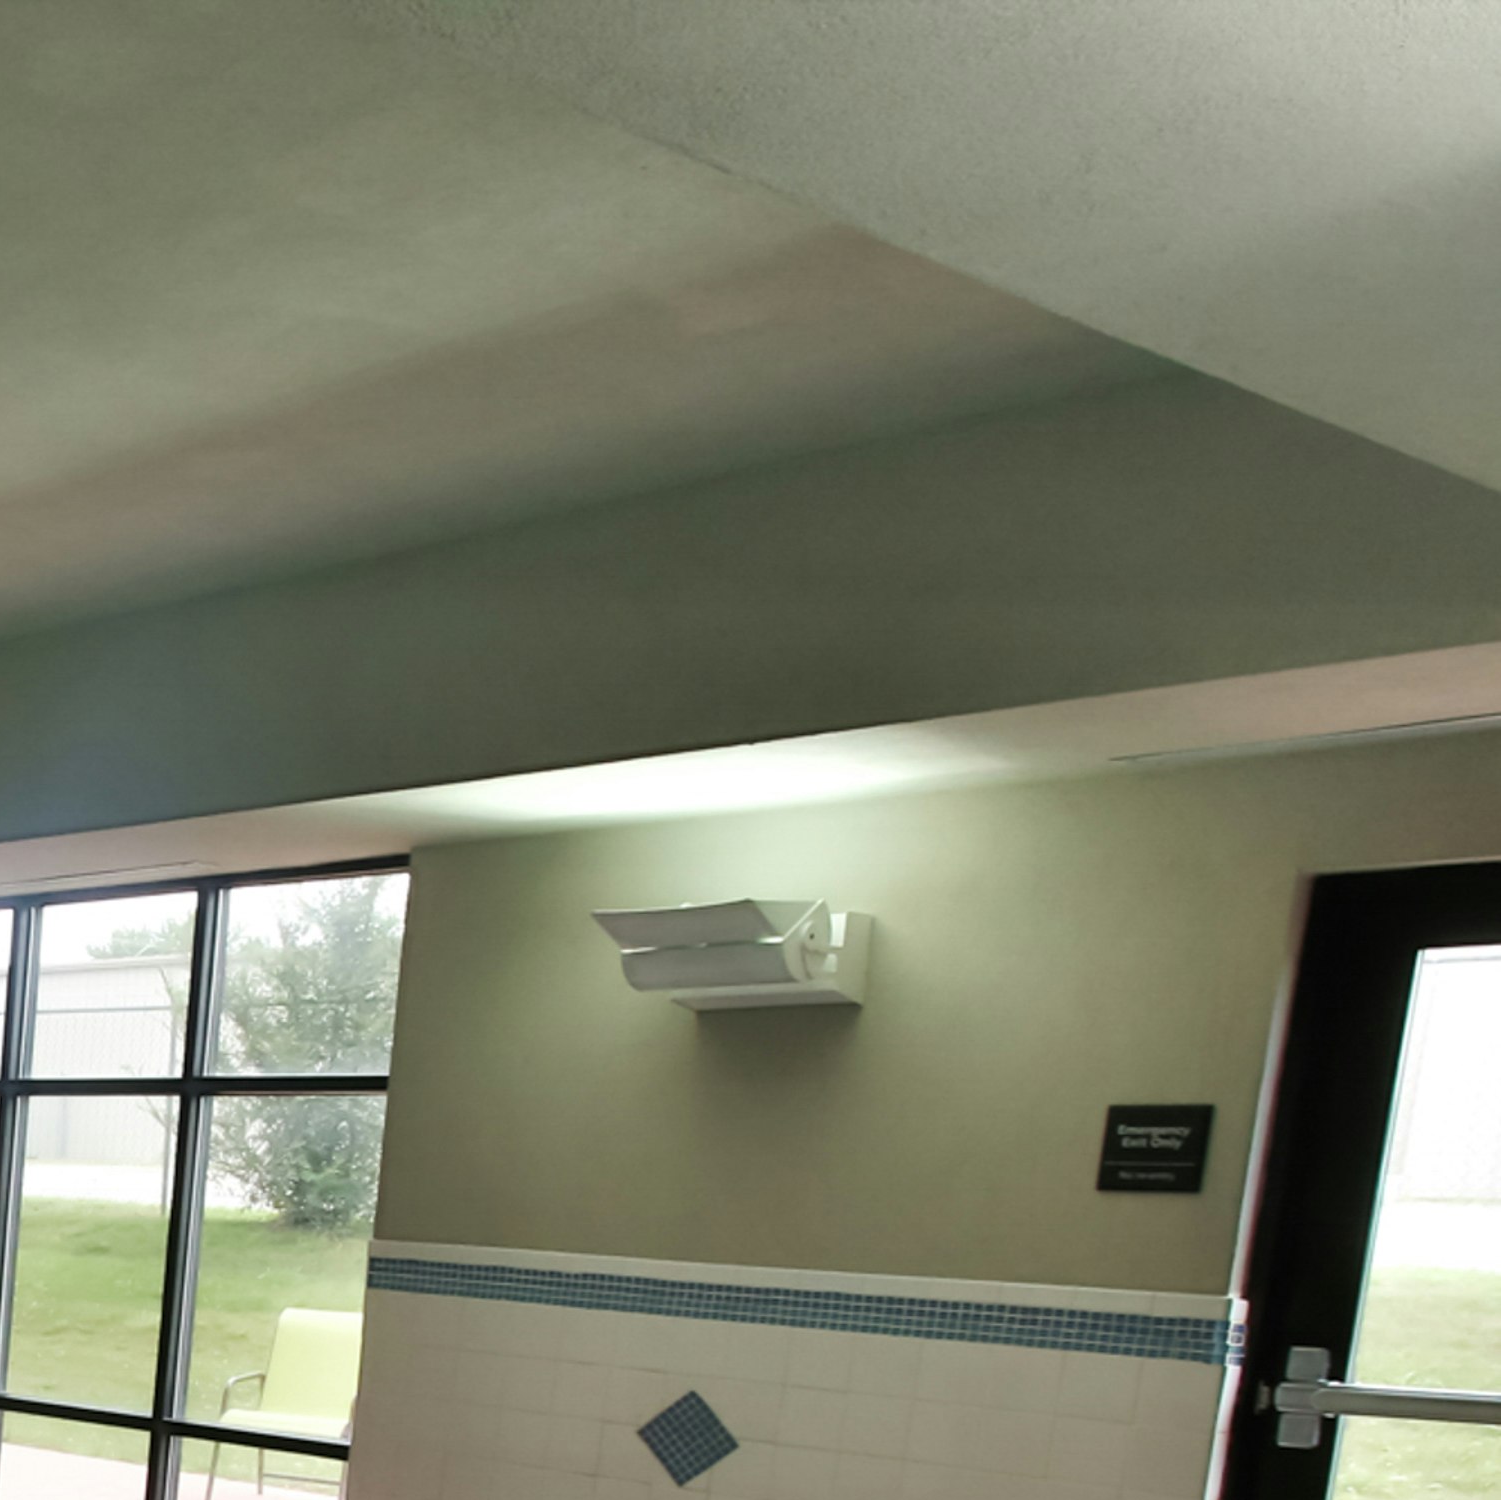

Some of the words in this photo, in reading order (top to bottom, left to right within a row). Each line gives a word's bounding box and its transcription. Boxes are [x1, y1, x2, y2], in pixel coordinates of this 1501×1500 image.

[1117, 1124, 1192, 1139] Emergency
[1121, 1137, 1148, 1149] Exit
[1150, 1137, 1184, 1151] Only
